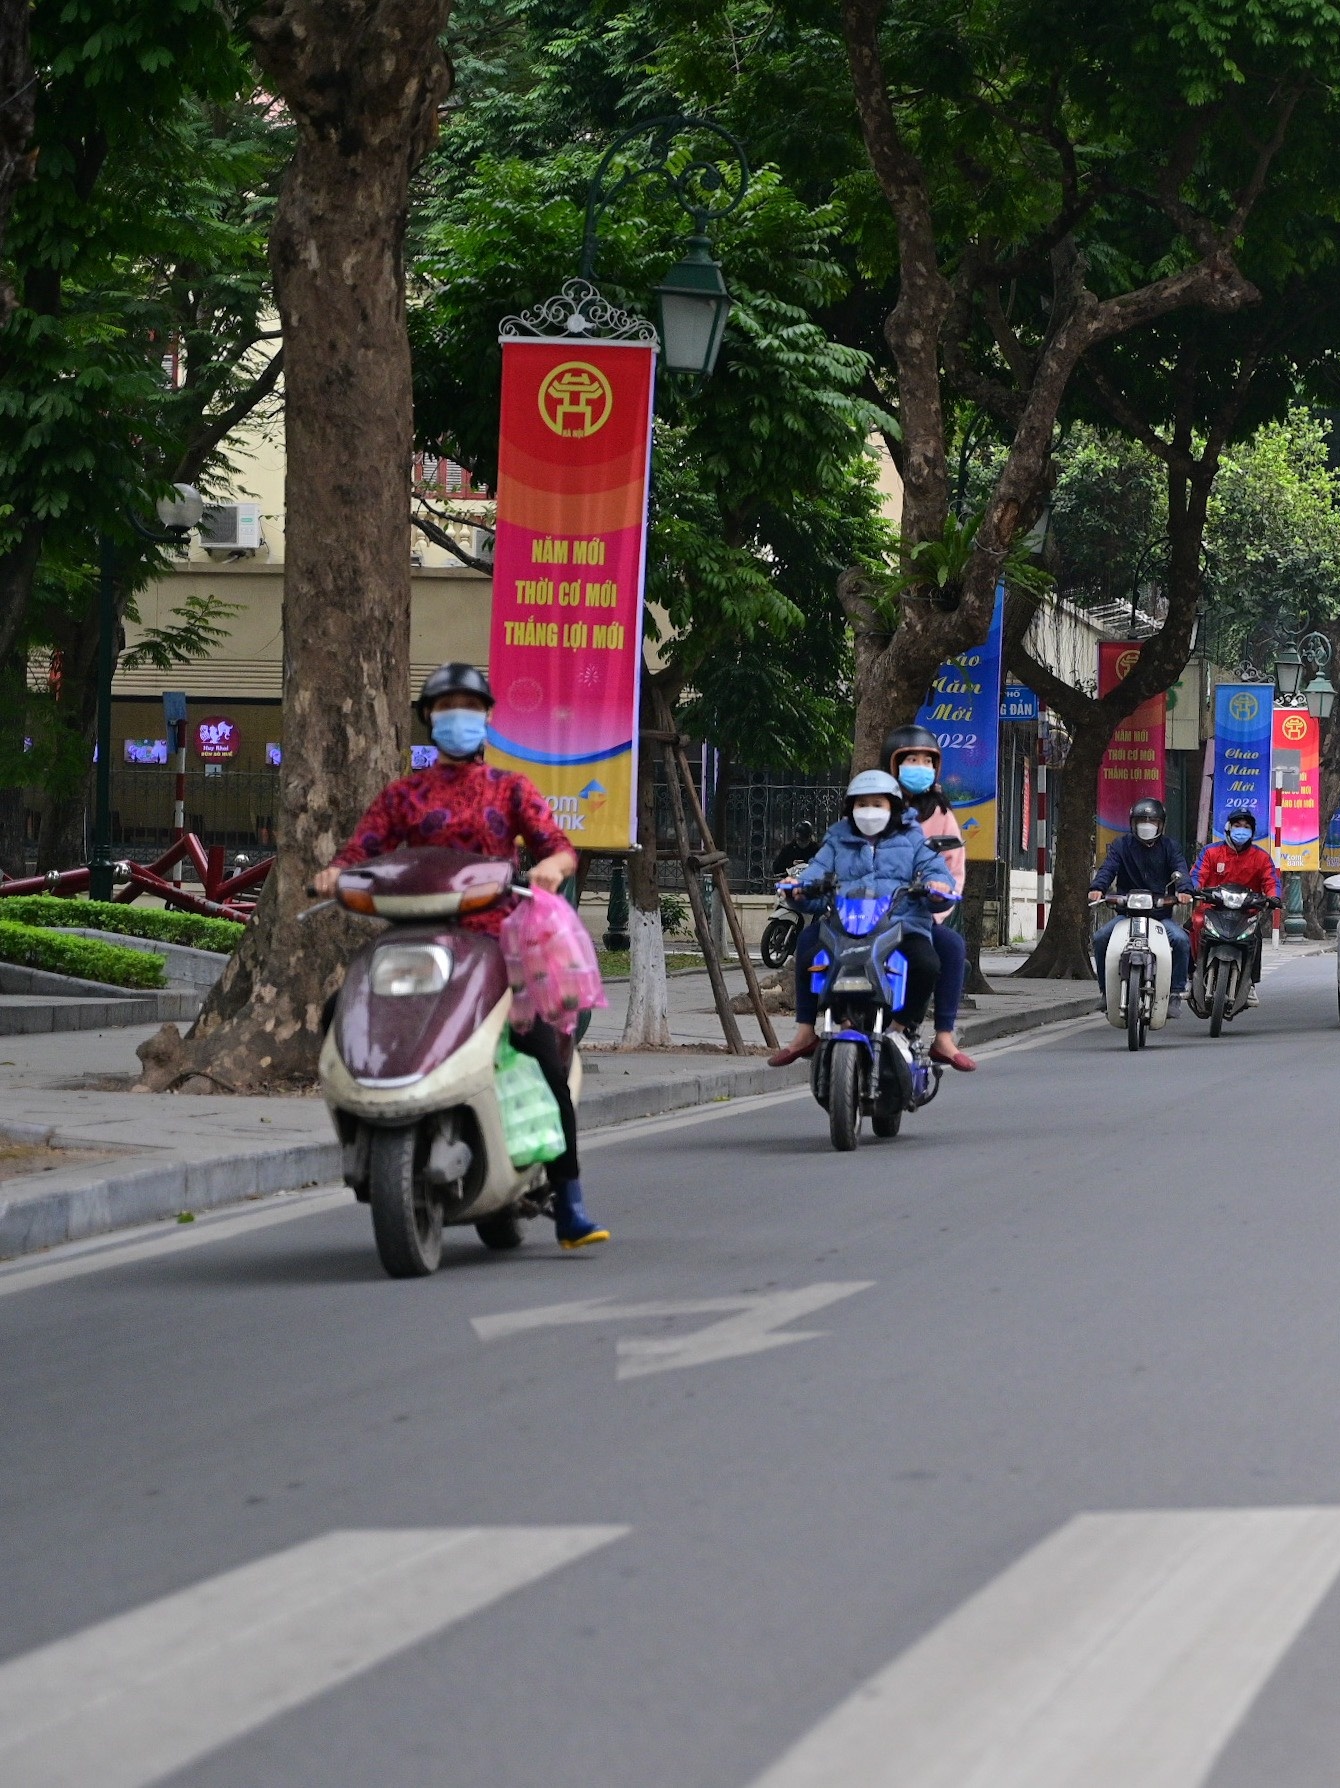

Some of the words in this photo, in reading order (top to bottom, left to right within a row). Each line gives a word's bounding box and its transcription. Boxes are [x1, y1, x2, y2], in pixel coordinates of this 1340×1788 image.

[531, 535, 569, 564] NĂM
[572, 537, 605, 566] MỚI
[515, 576, 554, 606] THỜI
[558, 579, 581, 607] CƠ
[585, 579, 617, 608] MỚI
[504, 615, 558, 648] THẮNG
[562, 621, 588, 653] LỢI
[592, 621, 625, 650] MỚI
[927, 703, 973, 721] Mới
[1009, 699, 1033, 716] ĐẢN
[932, 733, 977, 748] 022
[1225, 748, 1259, 759] Chào
[1223, 764, 1260, 776] Năm
[1226, 780, 1255, 792] Mới
[1224, 798, 1258, 808] 2022
